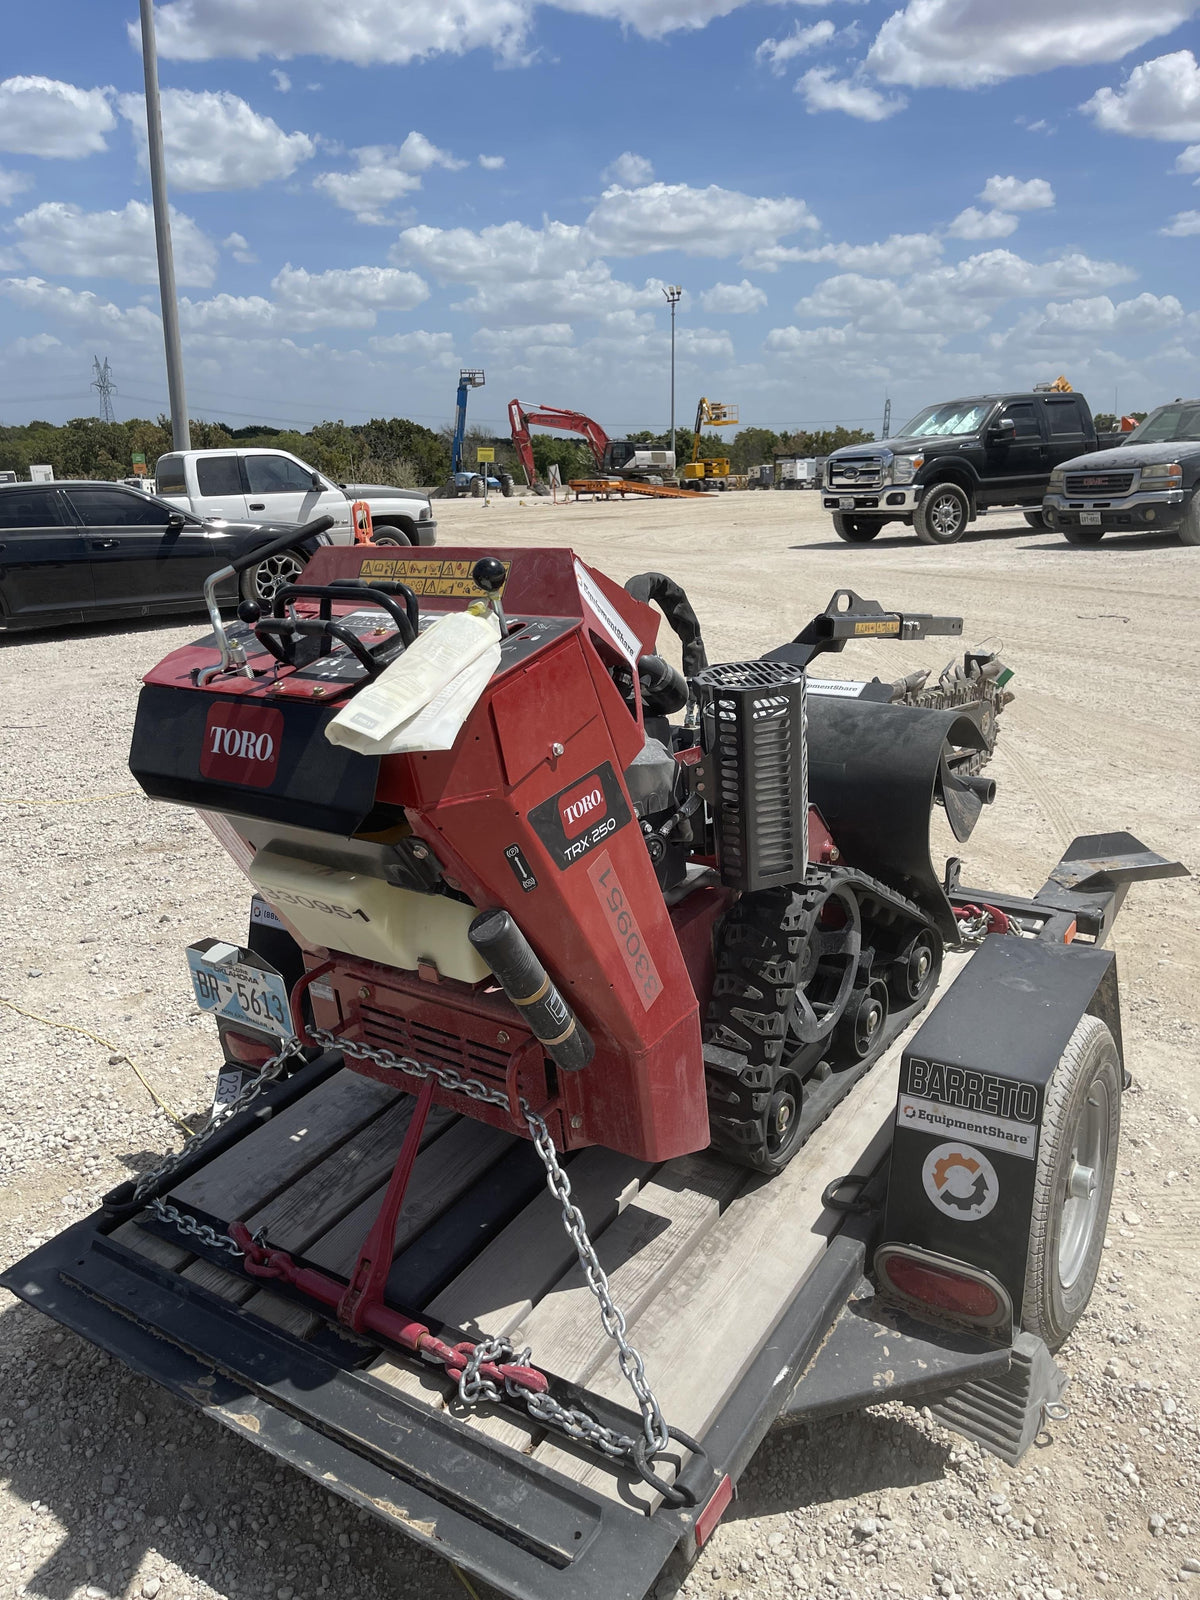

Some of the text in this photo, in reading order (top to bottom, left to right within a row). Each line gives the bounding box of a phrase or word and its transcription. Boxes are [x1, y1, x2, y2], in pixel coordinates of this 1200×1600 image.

[210, 726, 274, 761] TORO
[563, 789, 602, 824] TORO
[261, 886, 371, 922] 330951
[598, 867, 658, 999] 330951
[907, 1057, 1038, 1123] BARRETO
[917, 1109, 1028, 1145] EquipmentShare
